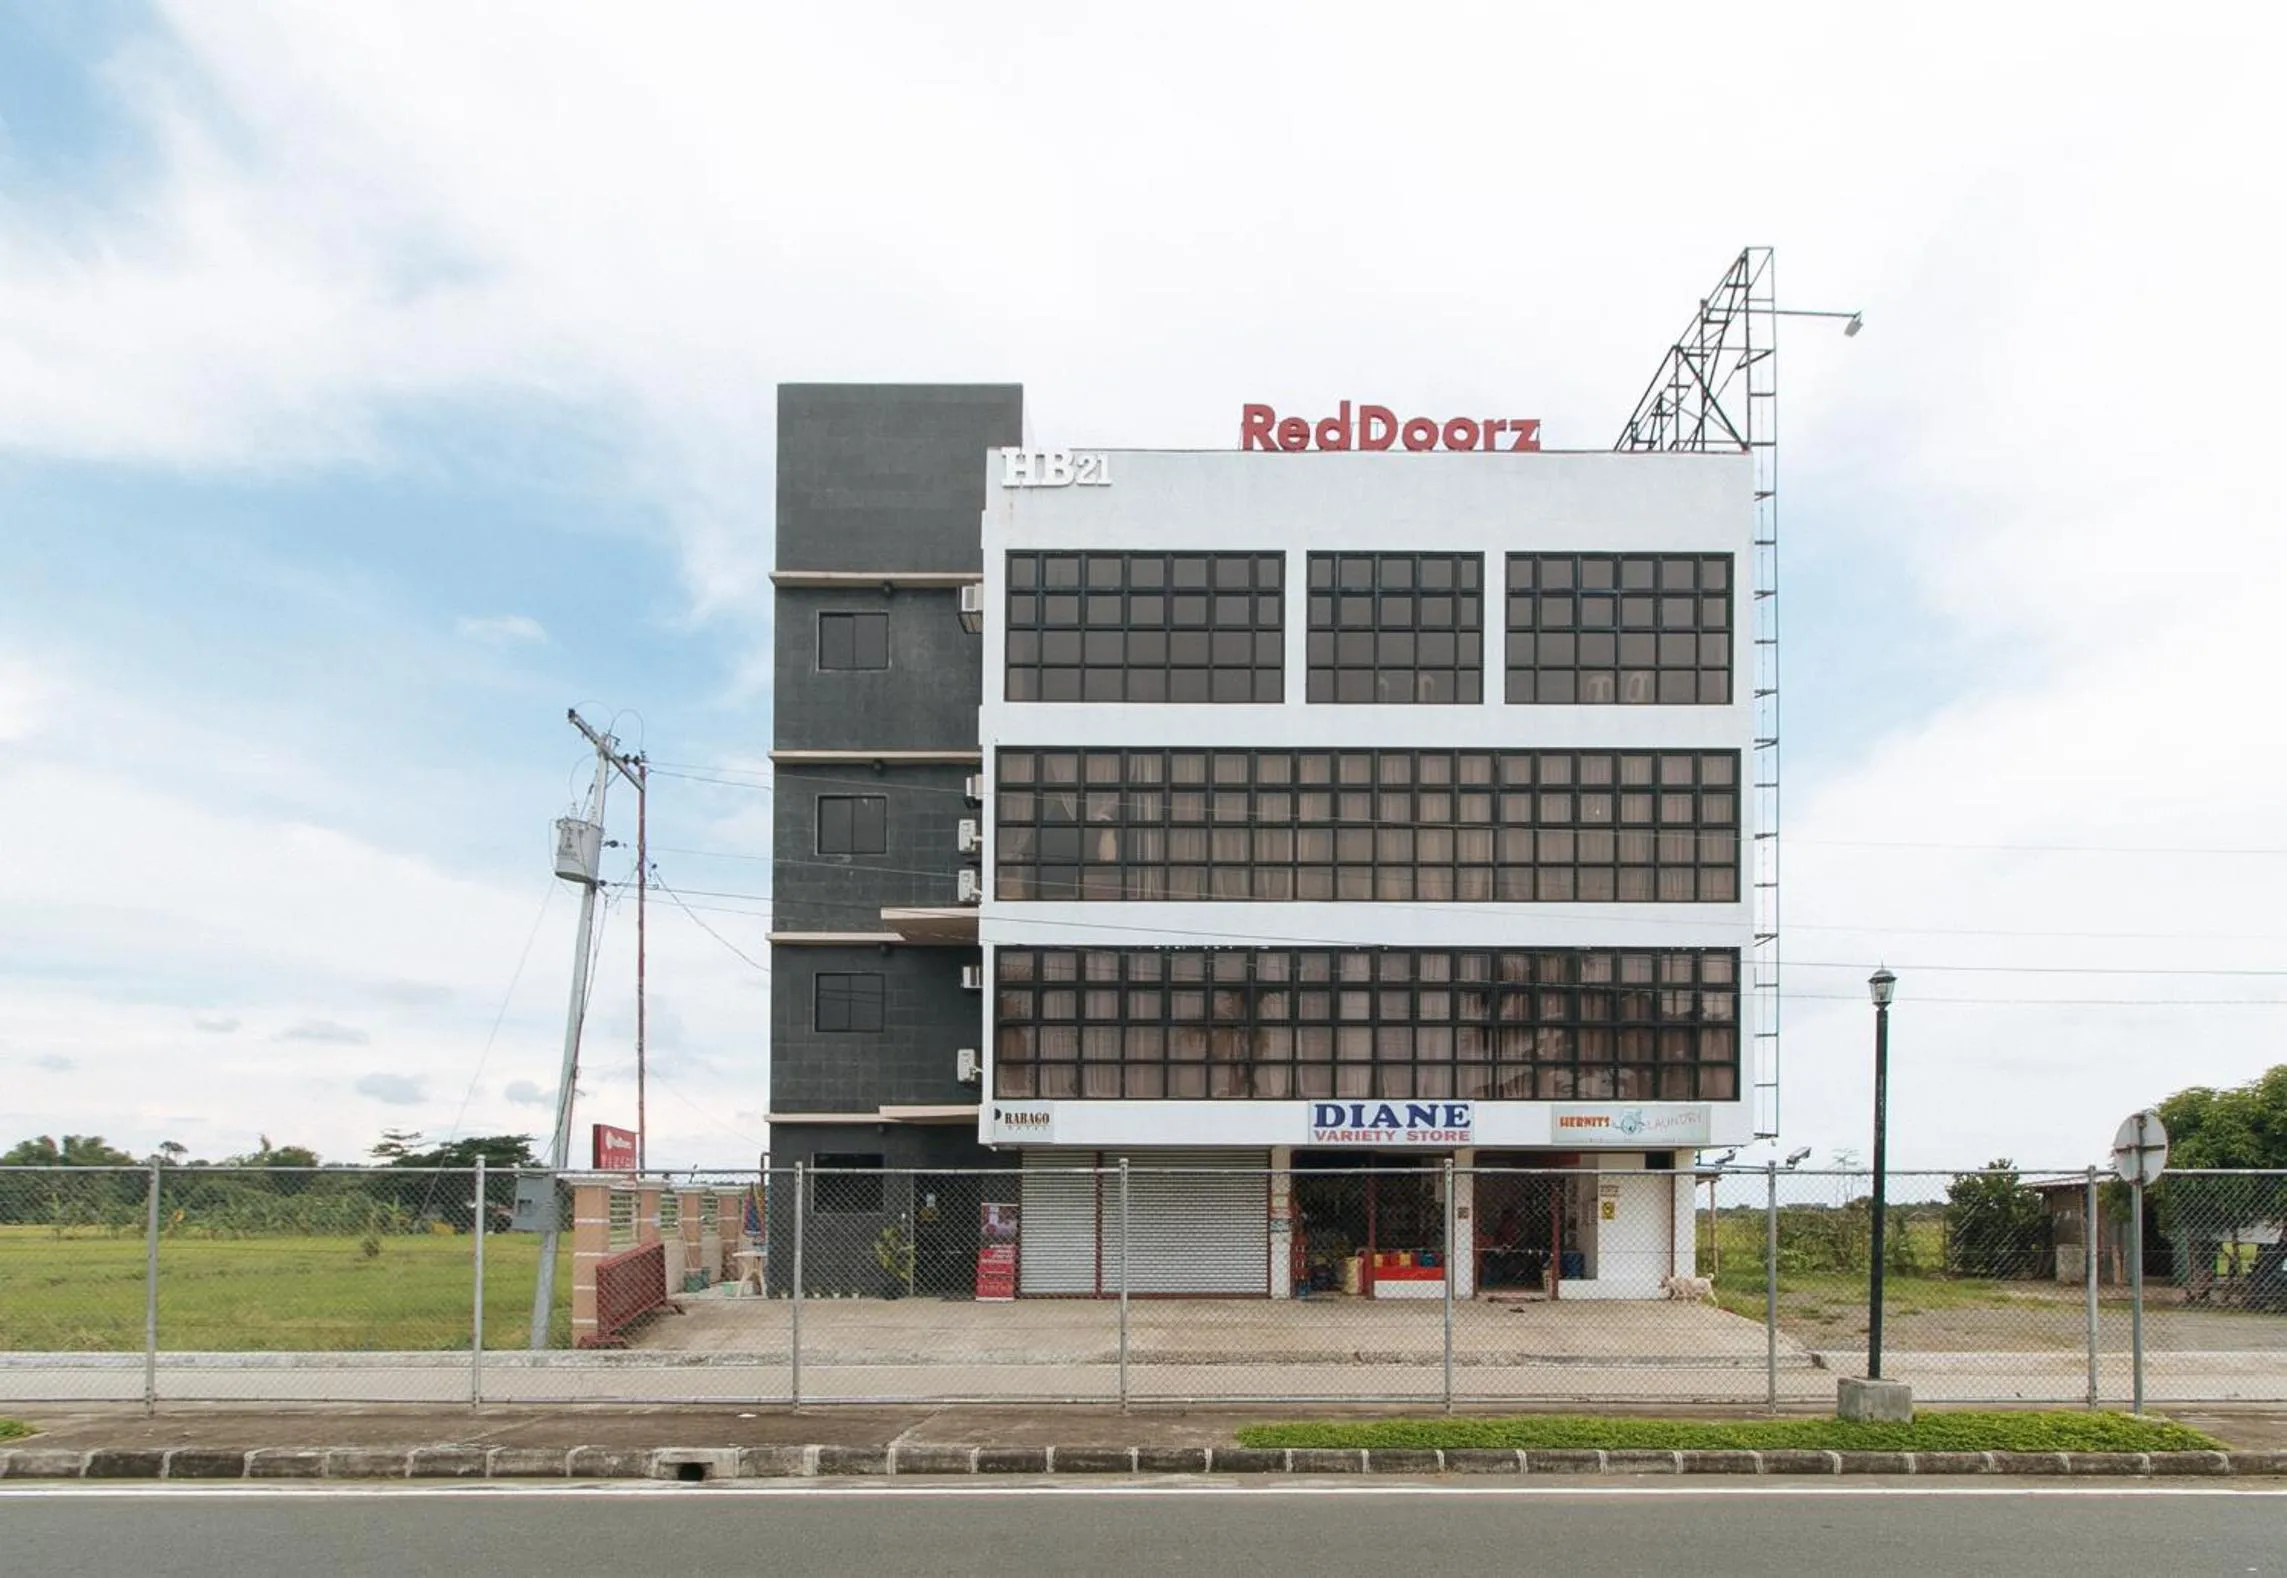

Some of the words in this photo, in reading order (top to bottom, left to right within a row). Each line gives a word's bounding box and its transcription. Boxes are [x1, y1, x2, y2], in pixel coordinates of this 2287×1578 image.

[1242, 399, 1541, 451] RedDoorz
[1001, 447, 1112, 488] HB21
[1004, 1112, 1050, 1125] RABAGO
[1313, 1103, 1472, 1128] DIANE
[1314, 1130, 1397, 1143] VARIETY
[1406, 1130, 1471, 1143] STORE
